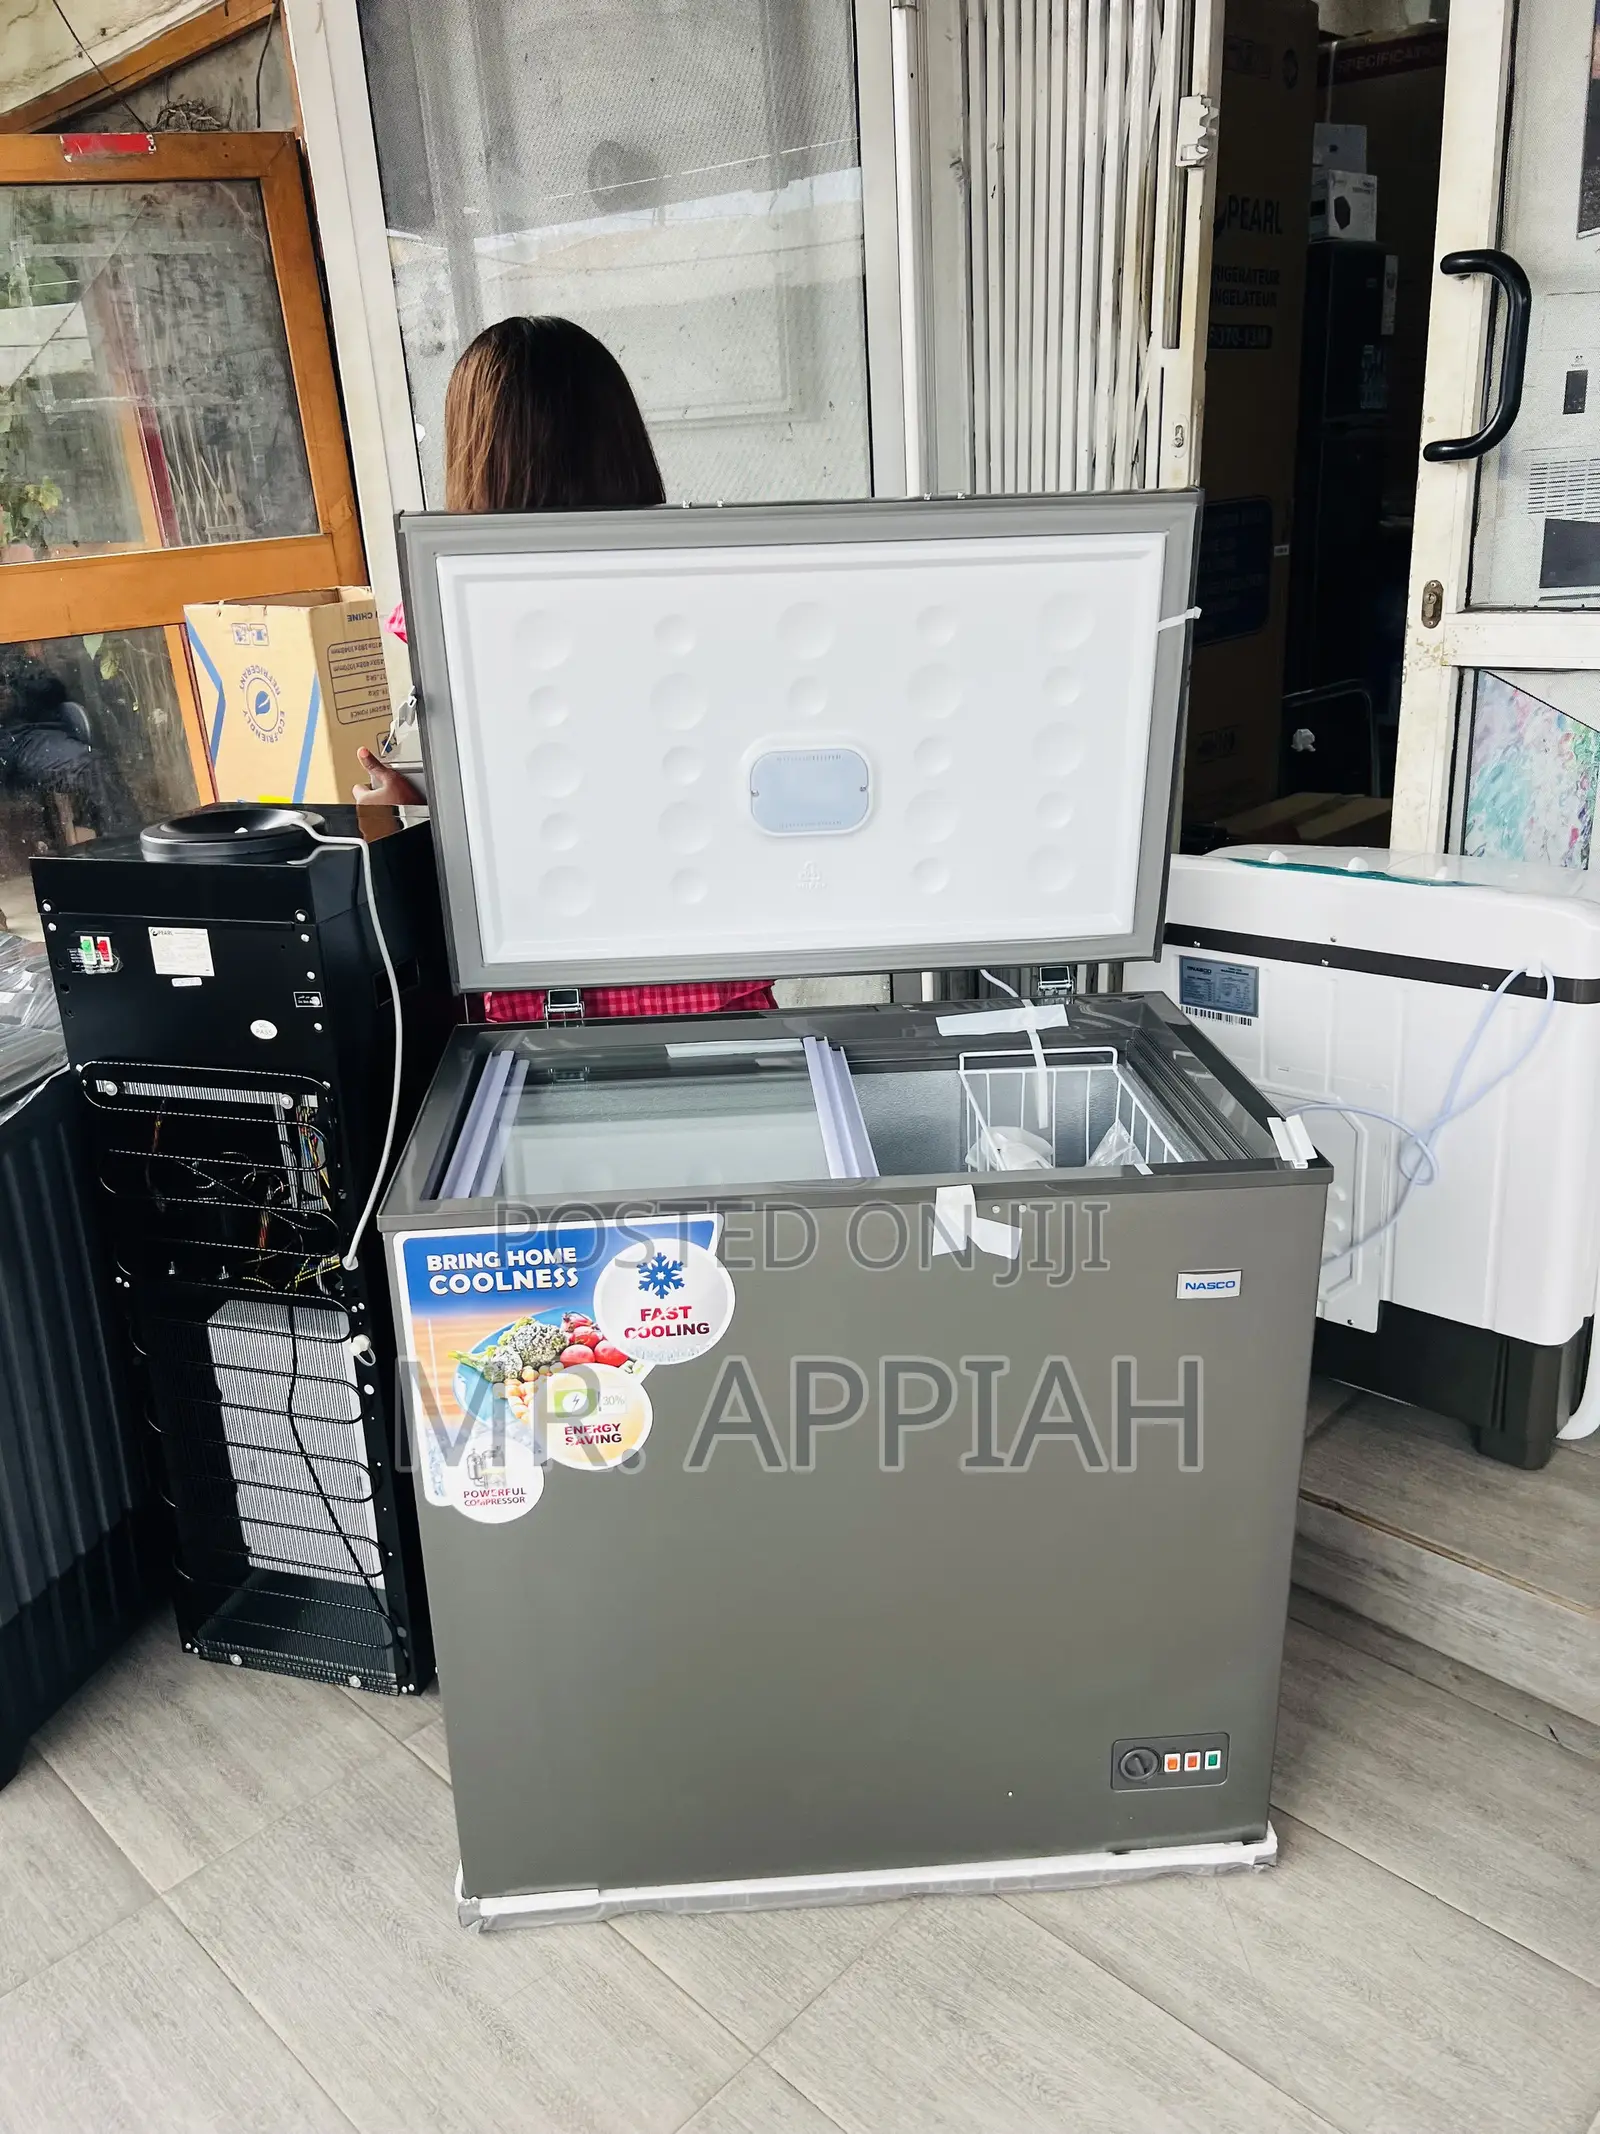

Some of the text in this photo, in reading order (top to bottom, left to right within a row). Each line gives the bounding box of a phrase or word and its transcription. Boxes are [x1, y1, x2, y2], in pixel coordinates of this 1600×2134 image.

[1227, 195, 1283, 235] PEARL
[1211, 287, 1277, 307] NGELATEUR
[347, 611, 373, 622] CHINE
[239, 664, 281, 696] REFRIGERANT
[427, 1247, 577, 1271] BRING HOME
[429, 1267, 579, 1295] COOLNESS
[1185, 1280, 1236, 1290] NASCO
[640, 1306, 692, 1321] FAST
[624, 1322, 710, 1339] COOLING
[602, 1395, 625, 1406] 30%
[564, 1423, 621, 1435] ENERGY
[565, 1434, 622, 1446] SAVING
[463, 1487, 526, 1498] POWERFUL
[464, 1496, 526, 1507] COMPRESSOR
